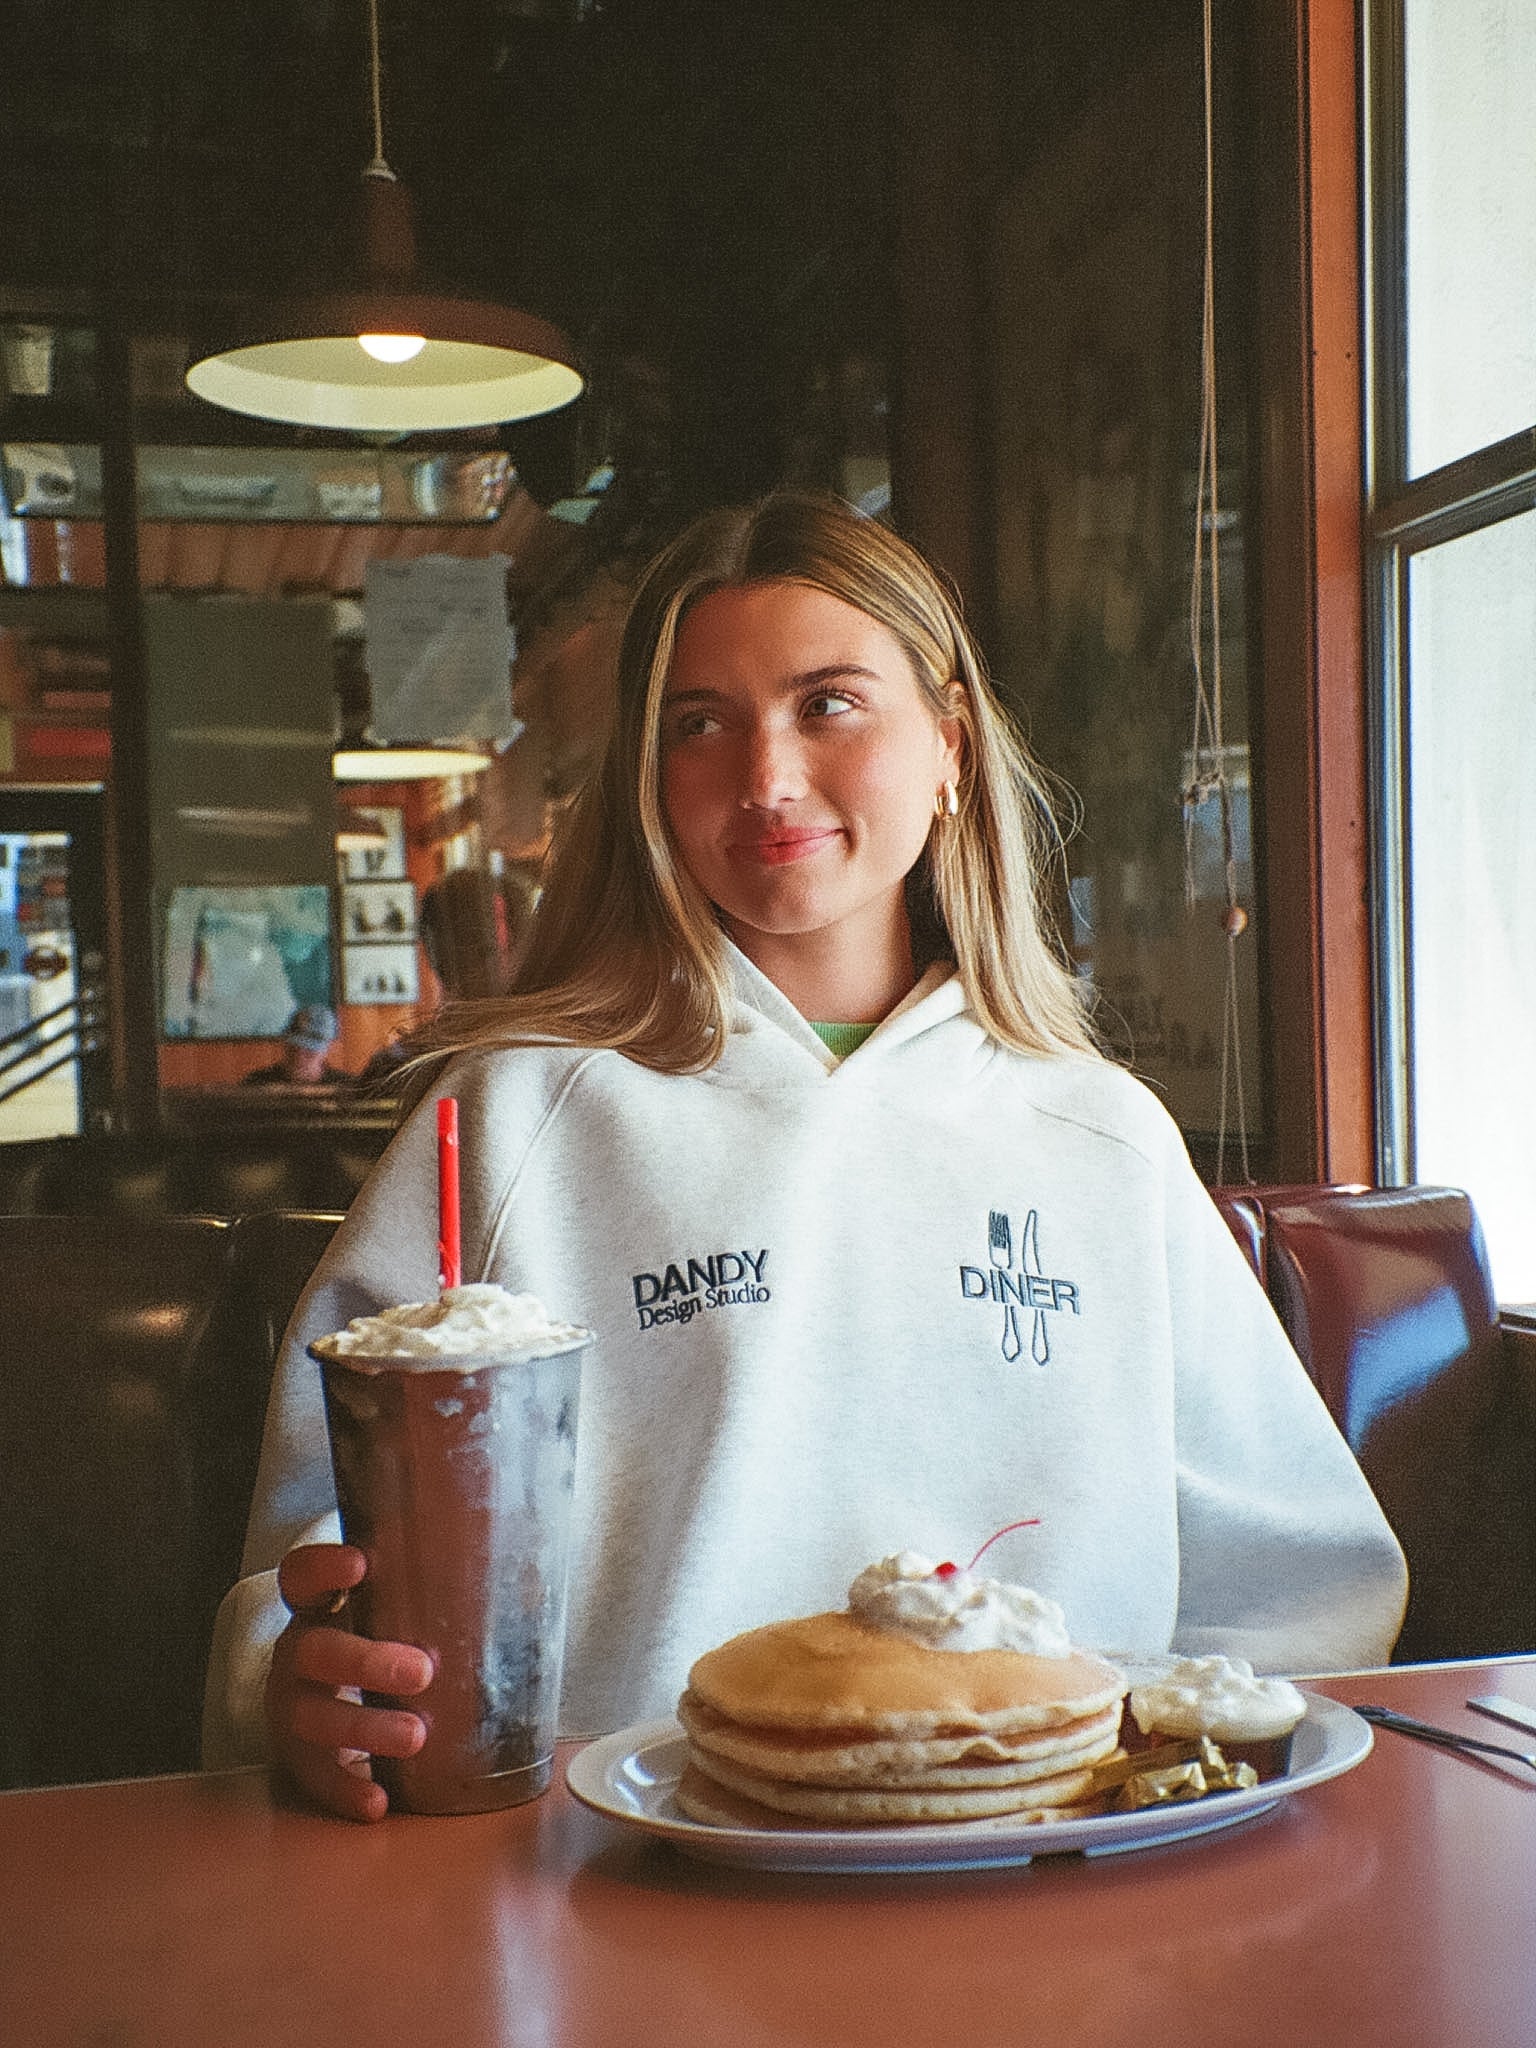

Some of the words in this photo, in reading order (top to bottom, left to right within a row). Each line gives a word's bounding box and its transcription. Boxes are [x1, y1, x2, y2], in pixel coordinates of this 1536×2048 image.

[633, 1249, 769, 1308] DANDY
[960, 1266, 1080, 1315] DINER
[637, 1297, 701, 1331] Design
[705, 1282, 771, 1309] Studio
